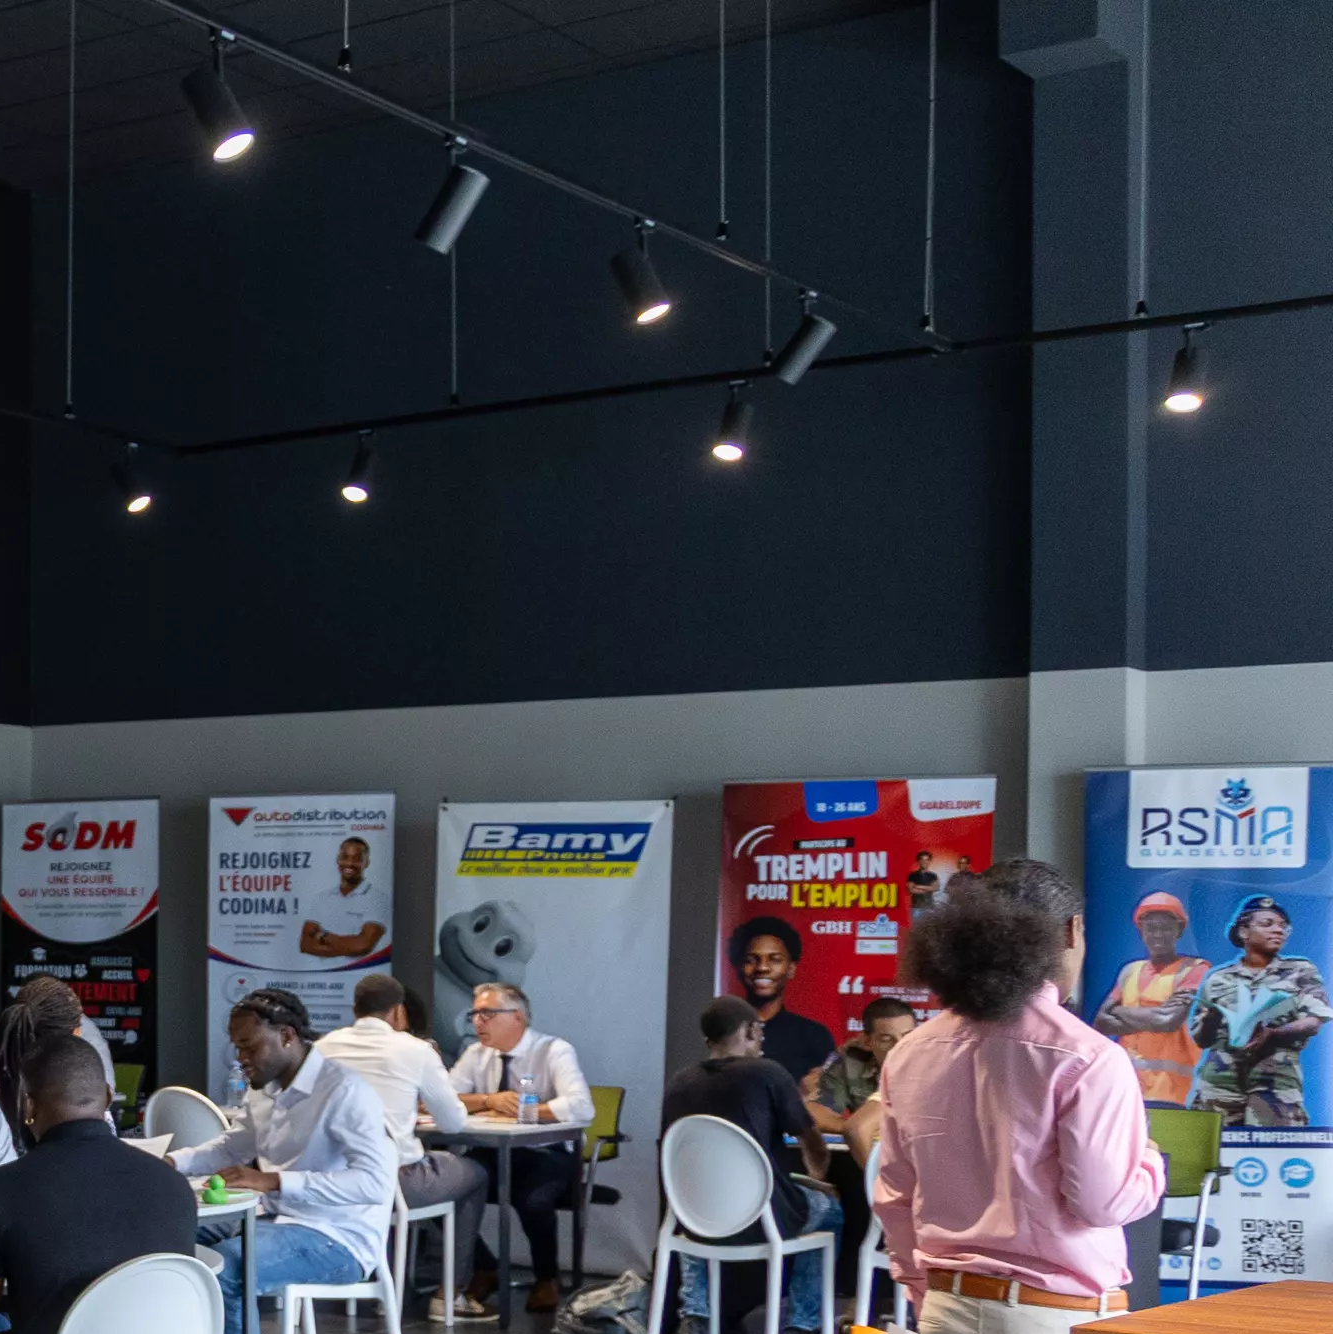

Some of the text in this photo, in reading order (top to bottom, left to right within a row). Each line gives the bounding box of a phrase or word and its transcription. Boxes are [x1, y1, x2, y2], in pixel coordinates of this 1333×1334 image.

[918, 800, 982, 811] GUADELOUPE
[253, 808, 387, 822] autodistribution
[1140, 806, 1294, 846] RSMA
[21, 818, 138, 851] SODM
[468, 825, 646, 856] Bamy
[527, 850, 606, 860] Pneus
[1139, 848, 1294, 857] GUADELOUPE
[50, 862, 113, 871] REJOIGNEZ
[219, 852, 312, 869] REJOIGNEZ
[754, 851, 887, 881] TREMPLIN
[47, 873, 114, 884] UNE ÉQUIPE
[219, 871, 292, 893] L'ÉQUIPE
[18, 888, 38, 898] QUI
[41, 888, 70, 898] VOUS
[73, 886, 137, 897] RESSEMBLE
[746, 883, 897, 909] POUR L'EMPLOI
[219, 898, 299, 915] CODIMA !
[810, 921, 852, 934] GBH
